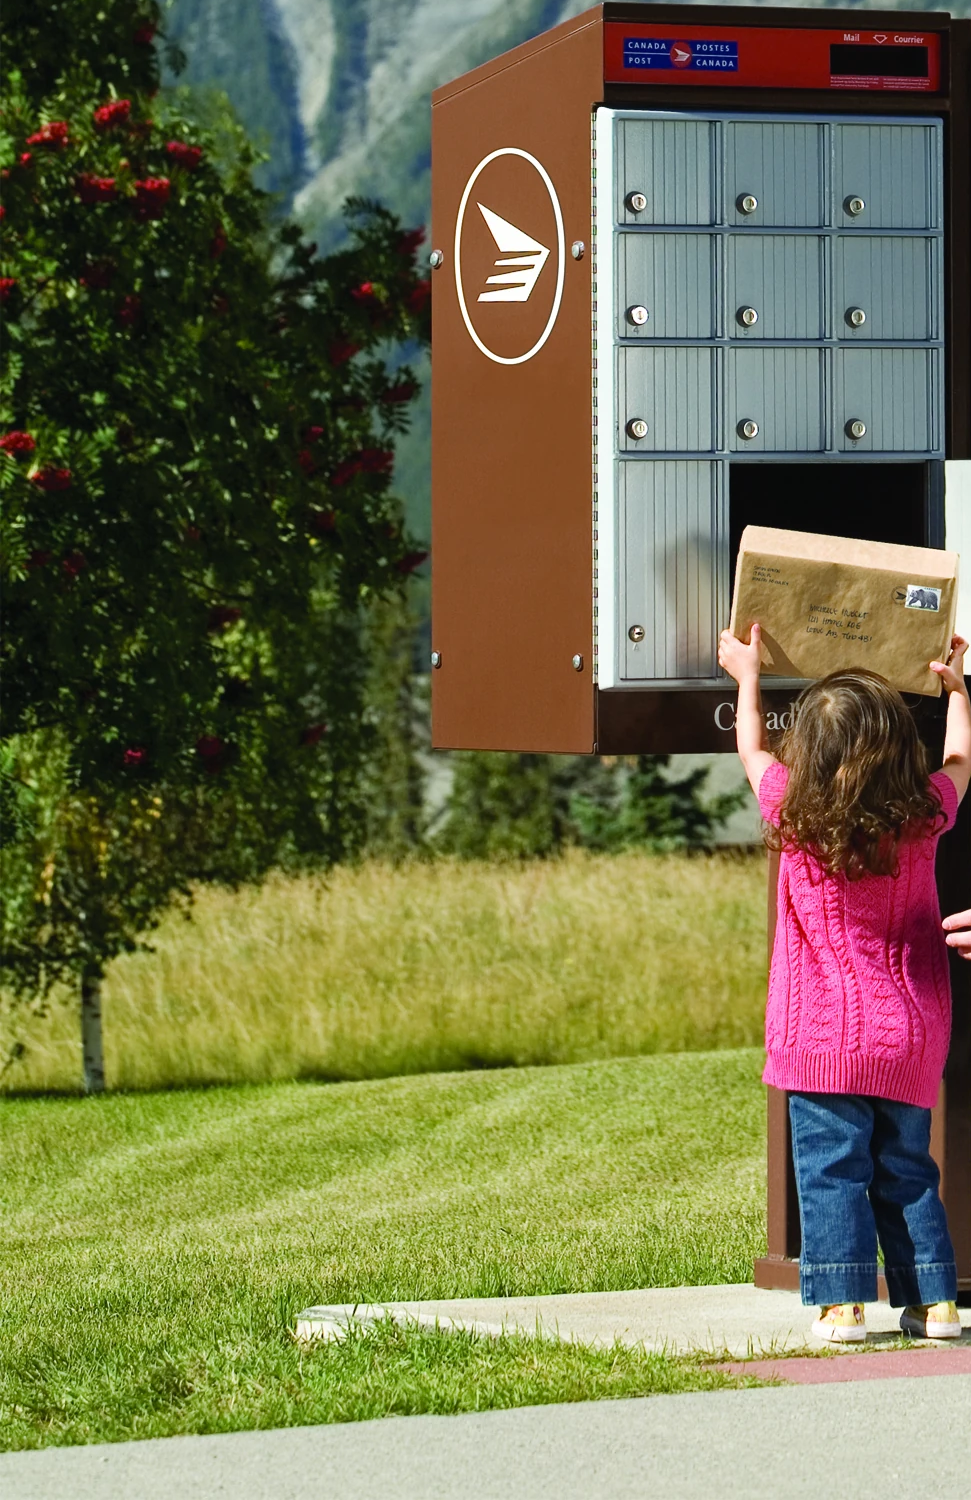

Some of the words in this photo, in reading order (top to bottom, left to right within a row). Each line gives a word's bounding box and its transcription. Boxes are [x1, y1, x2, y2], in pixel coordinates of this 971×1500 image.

[843, 33, 860, 42] Mail
[893, 35, 924, 44] Courrier
[628, 41, 667, 50] CANADA
[696, 44, 730, 52] POSTES
[628, 57, 652, 65] POST
[696, 59, 735, 68] CANADA
[633, 326, 640, 335] 4
